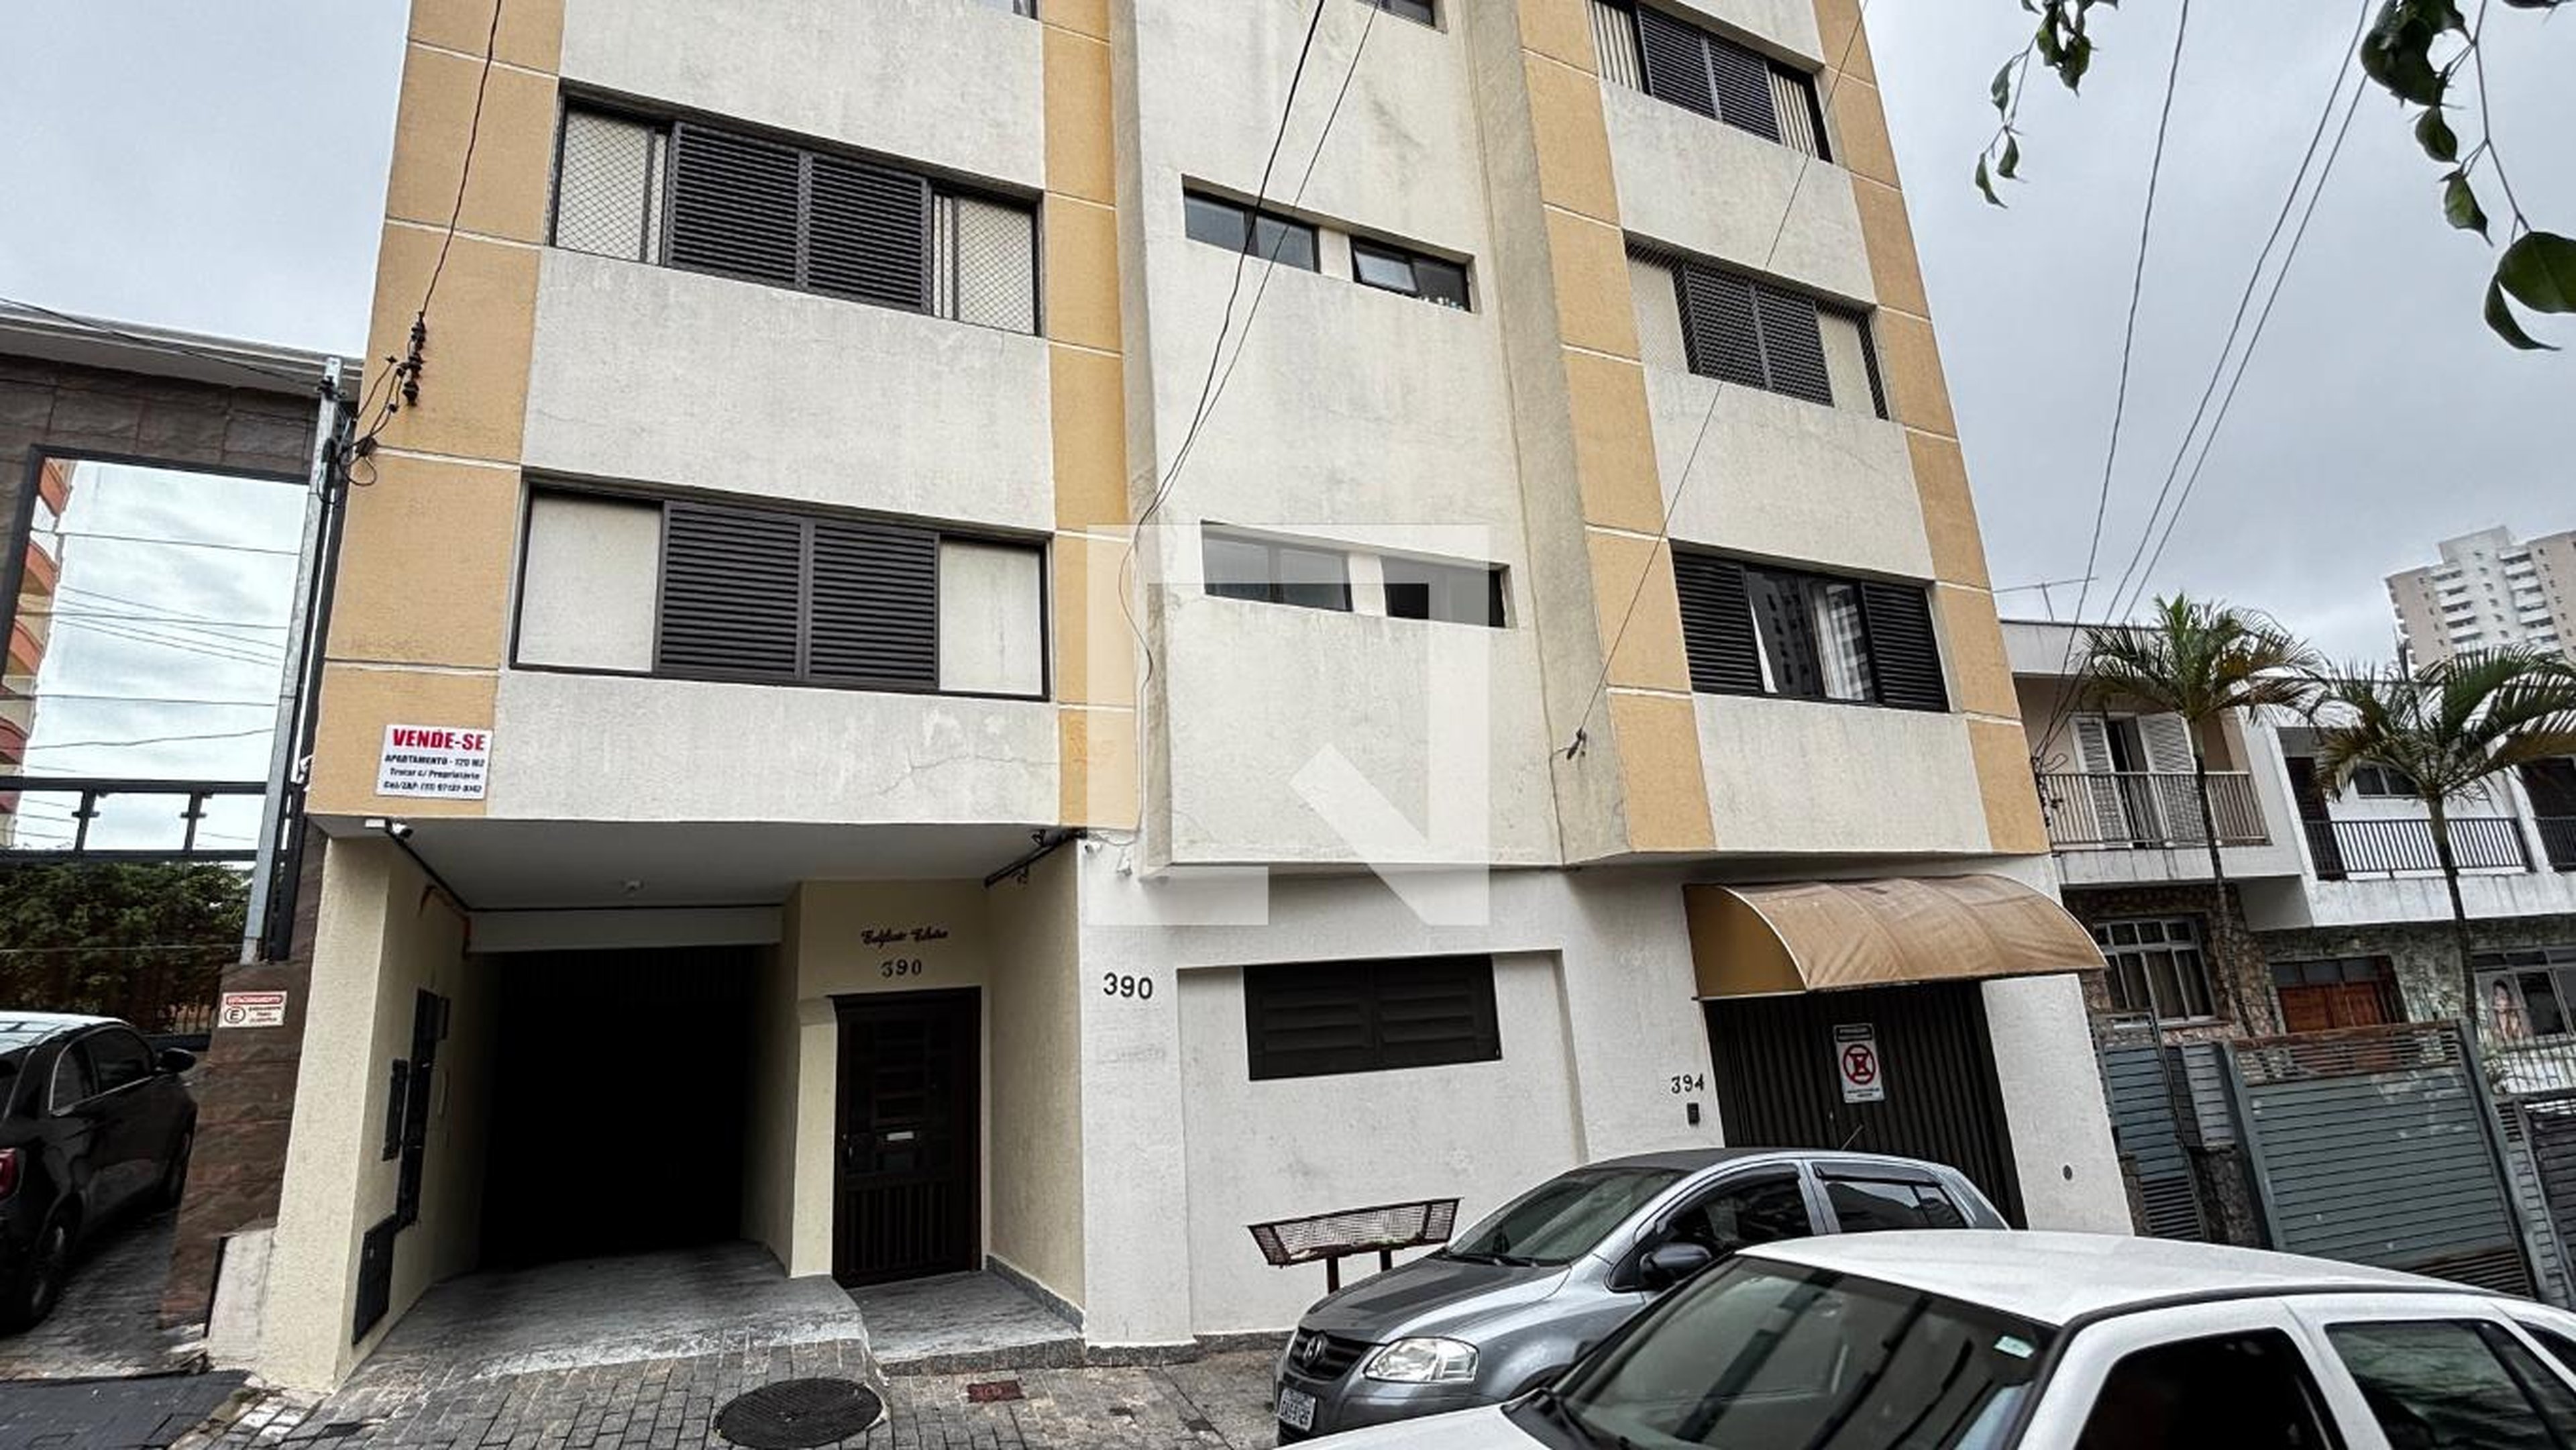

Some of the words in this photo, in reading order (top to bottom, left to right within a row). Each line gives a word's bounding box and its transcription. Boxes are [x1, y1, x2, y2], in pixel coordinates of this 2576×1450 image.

[392, 729, 486, 751] VENDE-SE
[384, 754, 448, 766] APARTAMENTO
[881, 959, 922, 978] 390
[1104, 972, 1152, 1000] 390
[1672, 1073, 1704, 1094] 394
